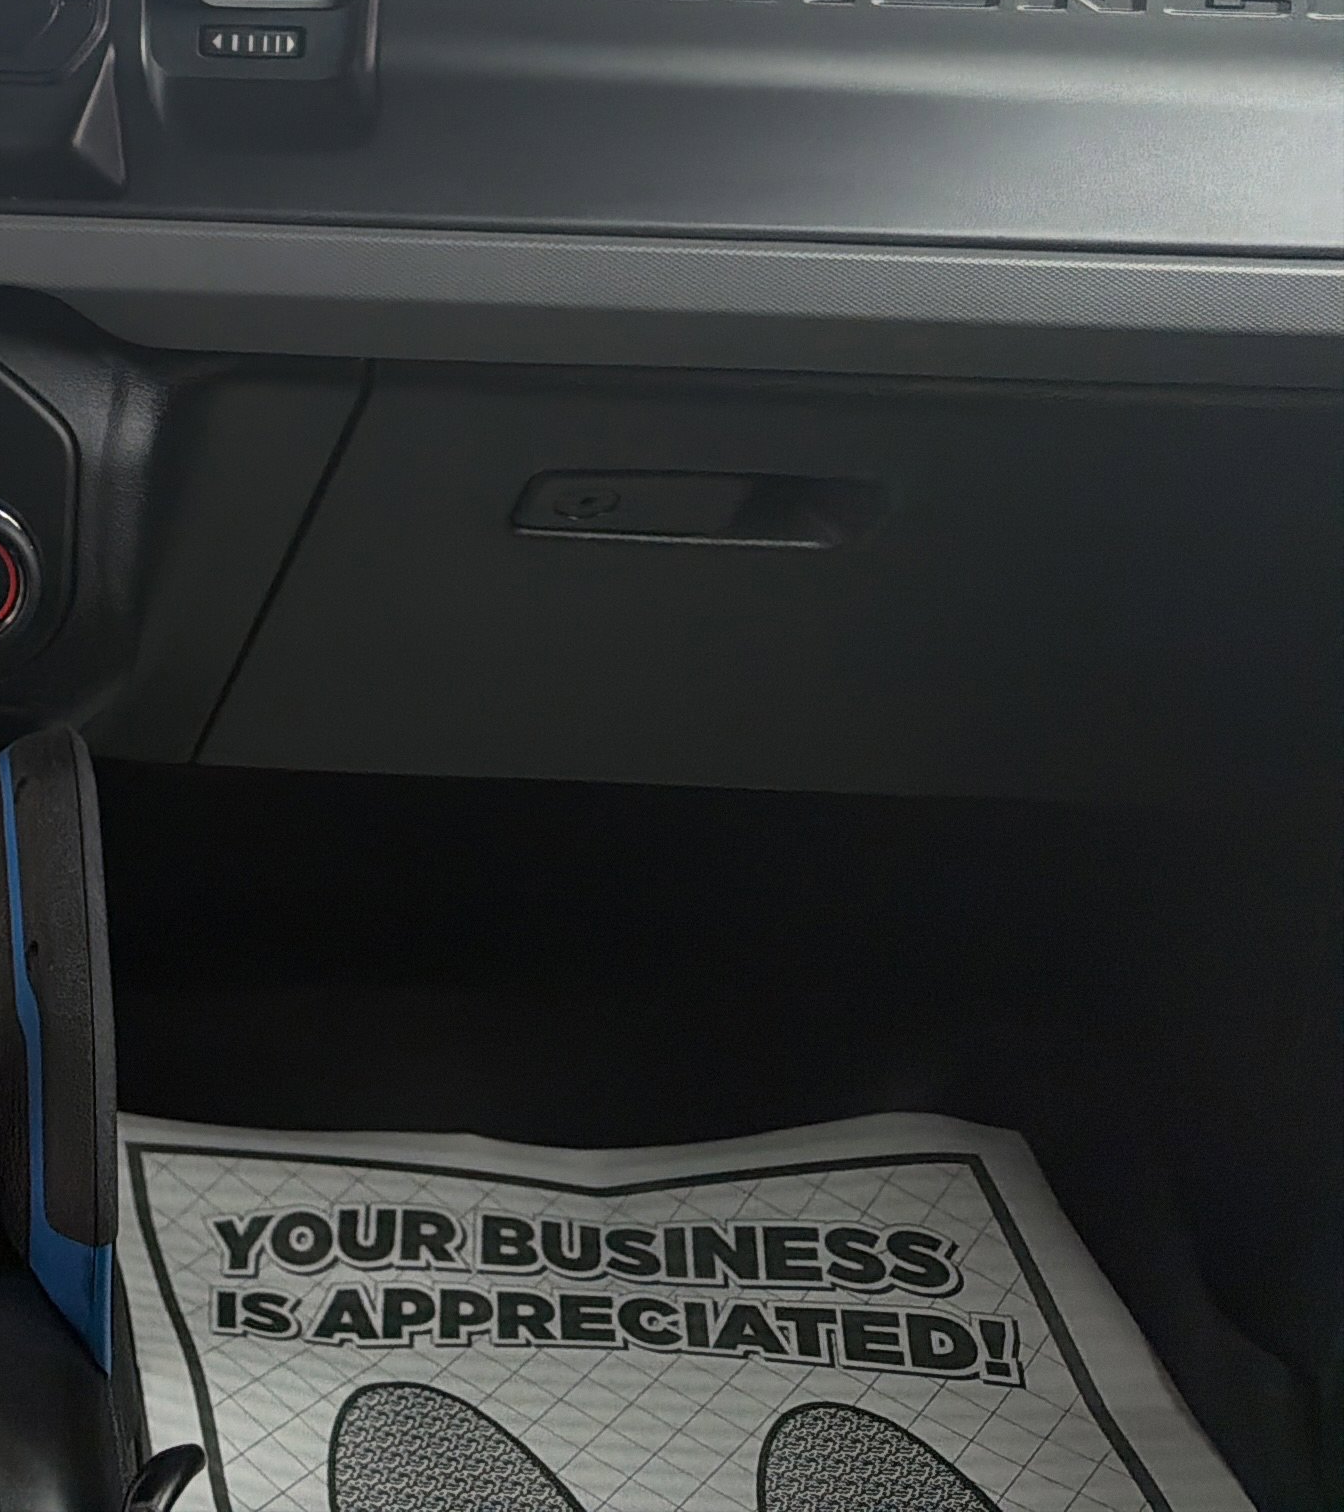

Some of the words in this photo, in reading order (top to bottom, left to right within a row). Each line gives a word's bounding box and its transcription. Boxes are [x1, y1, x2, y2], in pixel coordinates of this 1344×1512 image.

[214, 1208, 462, 1276] YOUR
[482, 1220, 962, 1295] BUSINESS
[214, 1287, 300, 1340] IS
[312, 1289, 1024, 1386] APPRECIATED!
